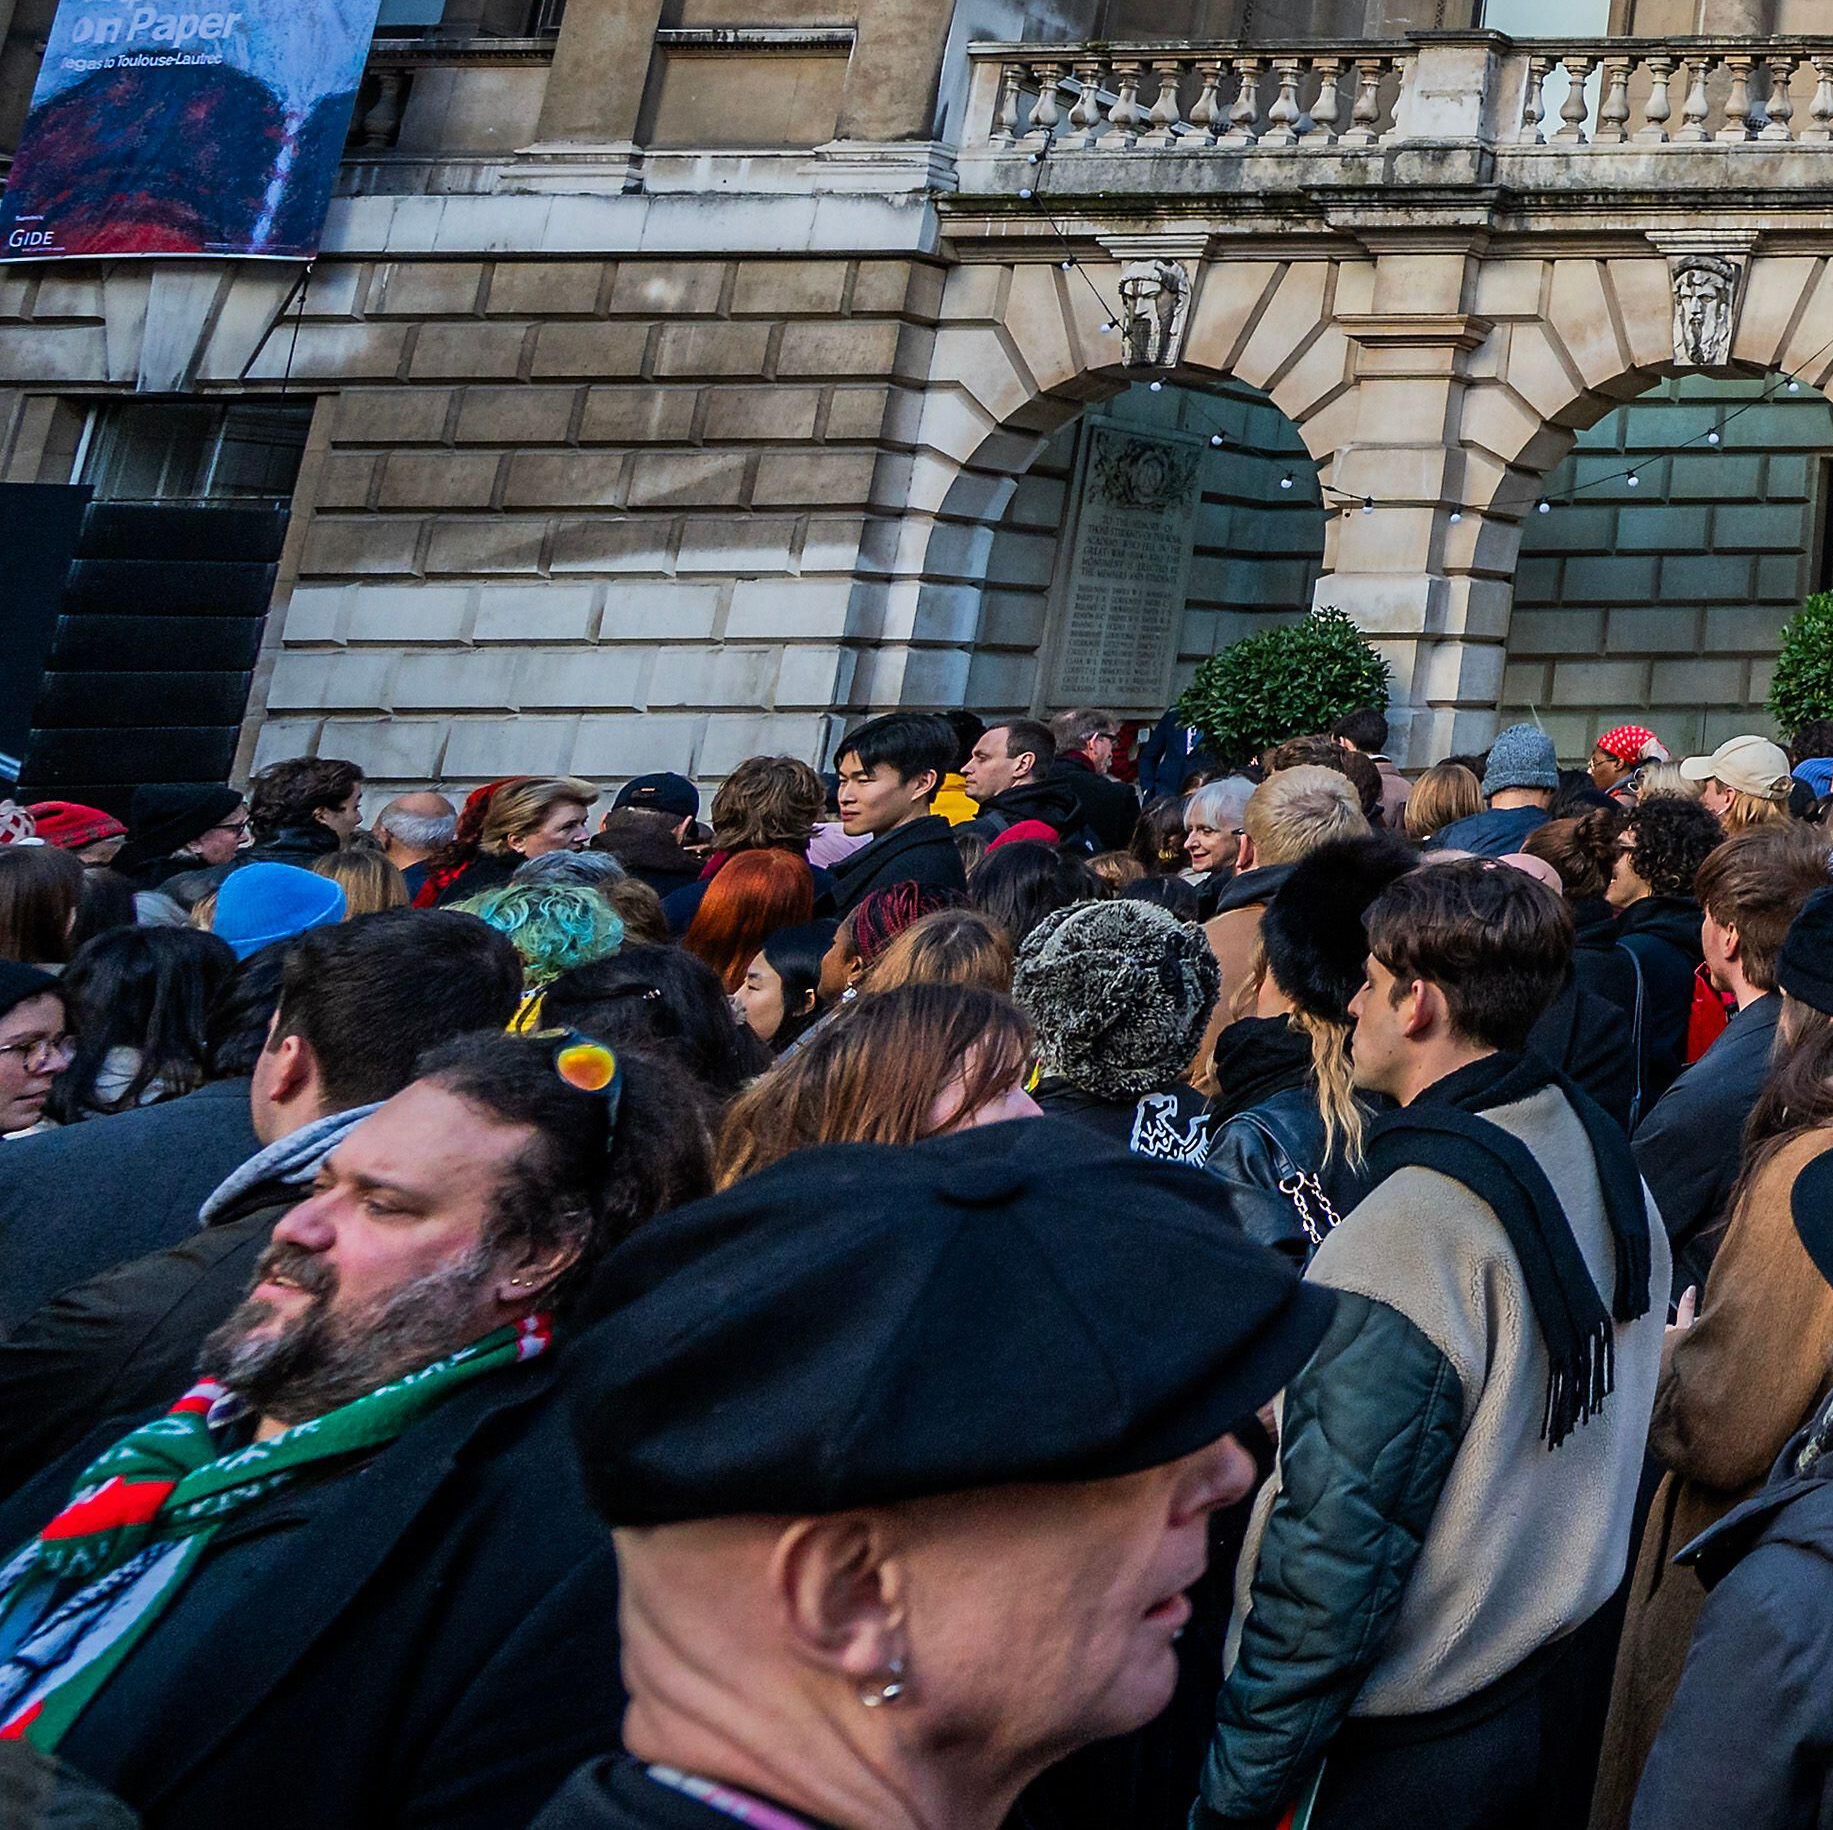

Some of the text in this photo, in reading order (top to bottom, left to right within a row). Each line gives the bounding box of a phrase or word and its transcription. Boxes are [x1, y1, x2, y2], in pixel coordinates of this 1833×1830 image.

[71, 7, 242, 48] on Paper
[104, 56, 116, 69] to
[117, 52, 224, 68] Toulouse-Lautrec
